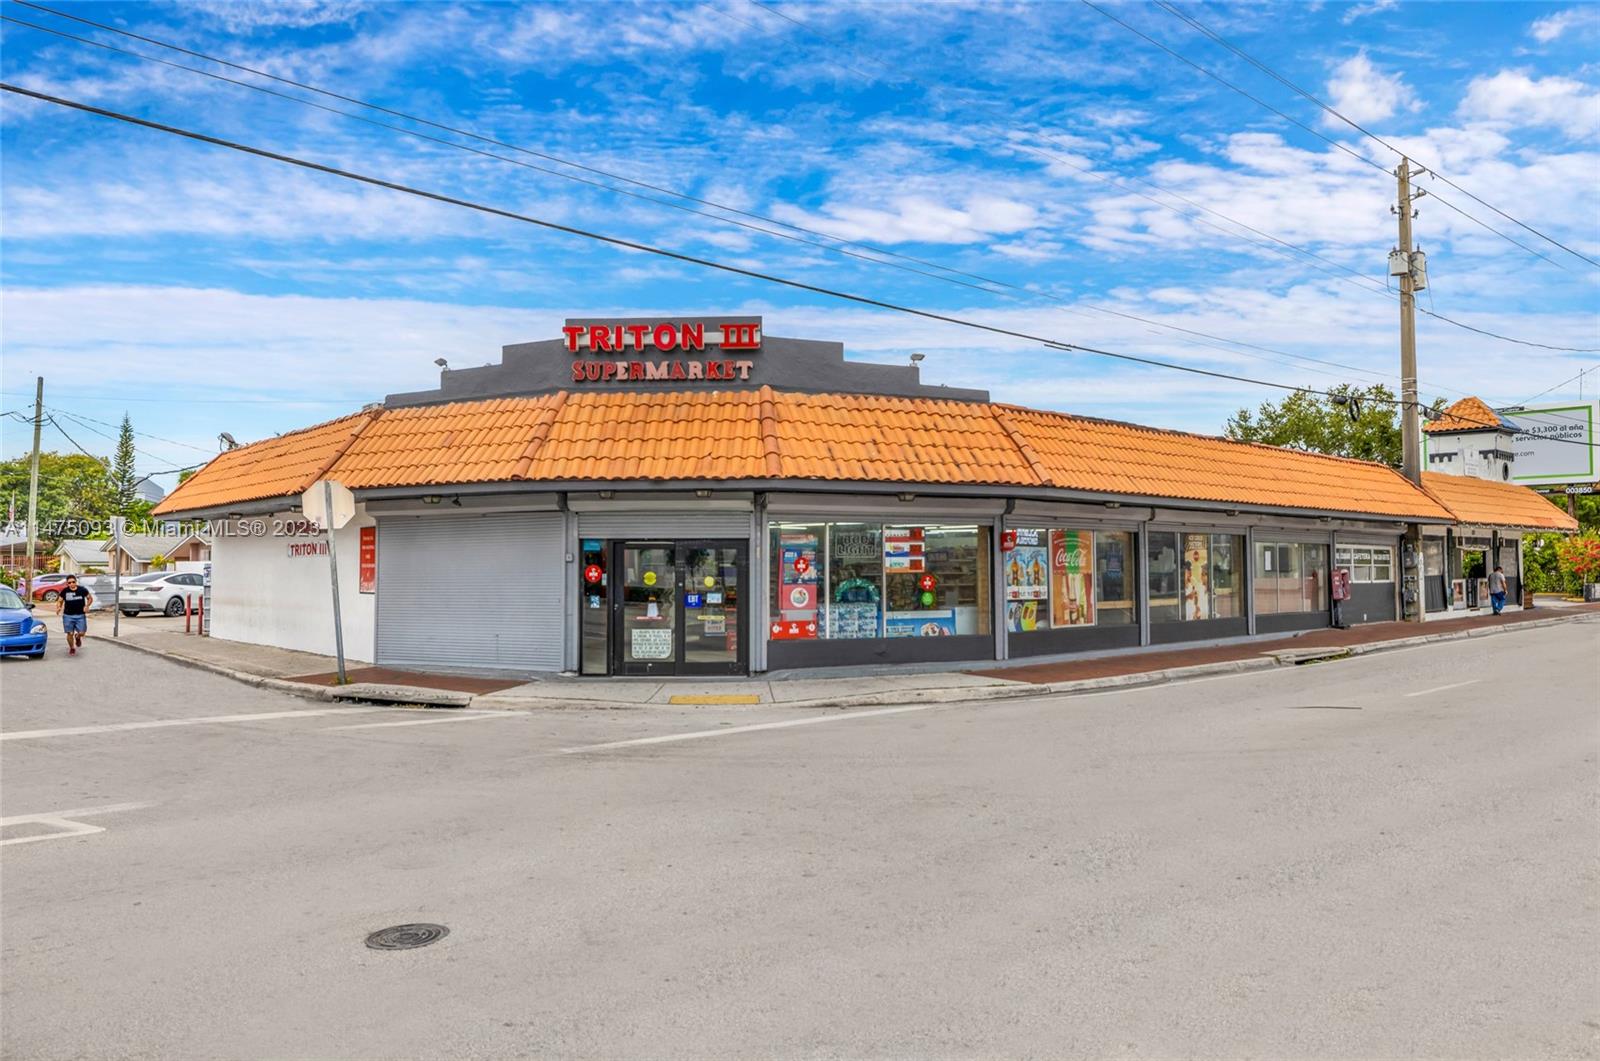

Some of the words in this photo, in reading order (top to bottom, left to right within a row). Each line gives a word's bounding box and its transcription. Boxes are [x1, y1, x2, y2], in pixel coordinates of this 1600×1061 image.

[563, 323, 703, 351] TRITON
[720, 324, 760, 348] III
[572, 360, 753, 381] SUPERMARKET
[1549, 432, 1582, 441] públicos
[290, 543, 317, 557] TRITON
